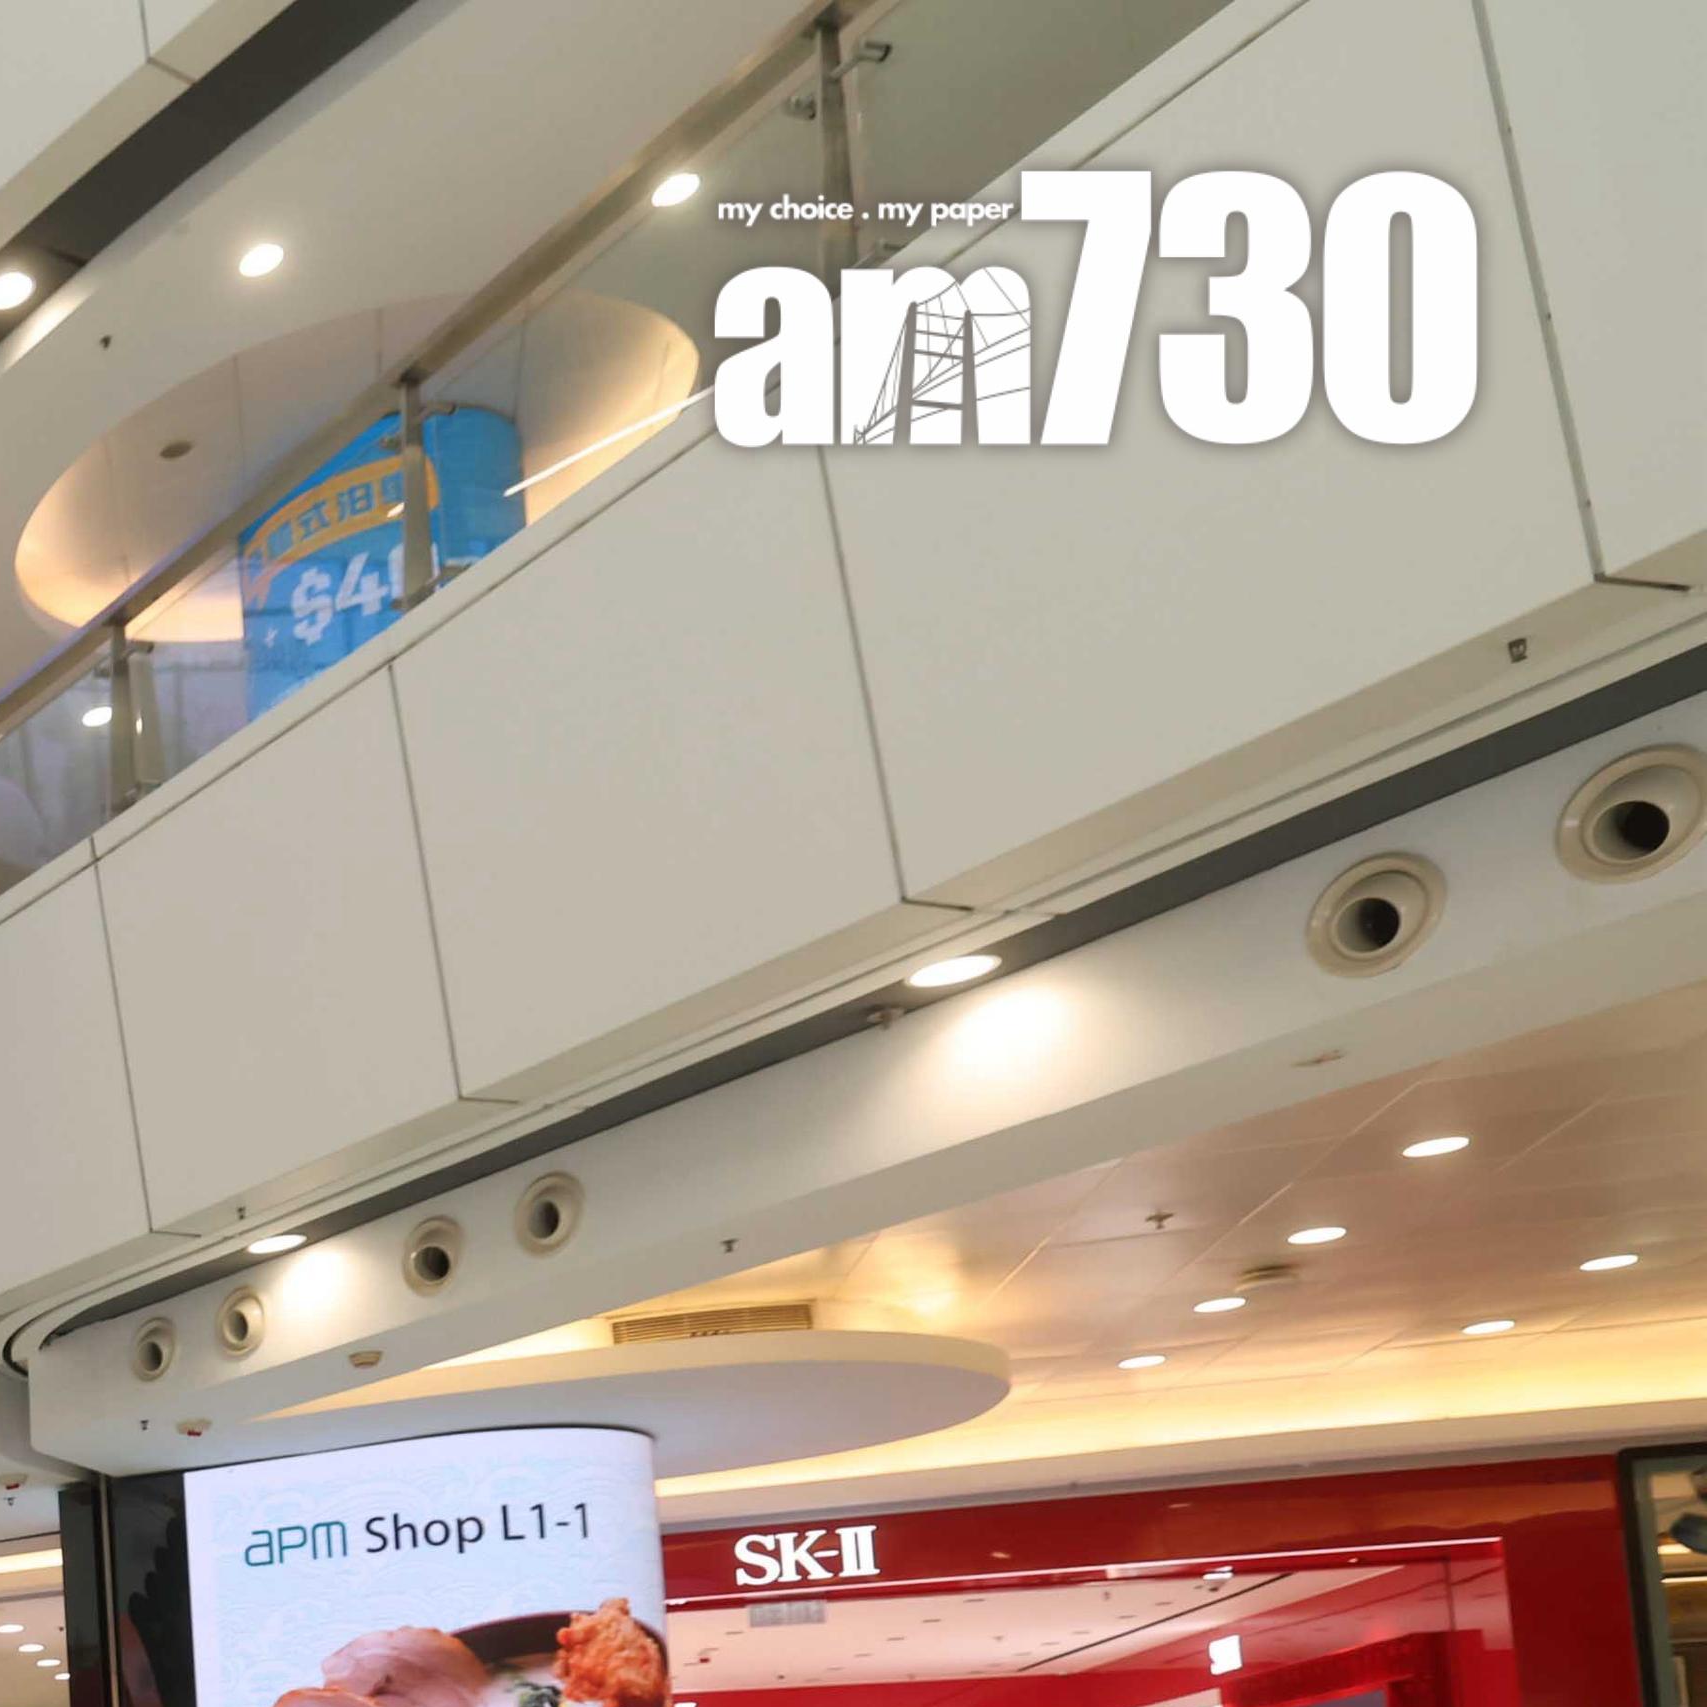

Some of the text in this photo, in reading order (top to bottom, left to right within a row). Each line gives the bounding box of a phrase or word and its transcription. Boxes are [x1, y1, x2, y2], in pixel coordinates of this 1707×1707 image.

[365, 1512, 485, 1555] Shop
[501, 1502, 589, 1541] L1-1
[734, 1524, 881, 1586] SK-II
